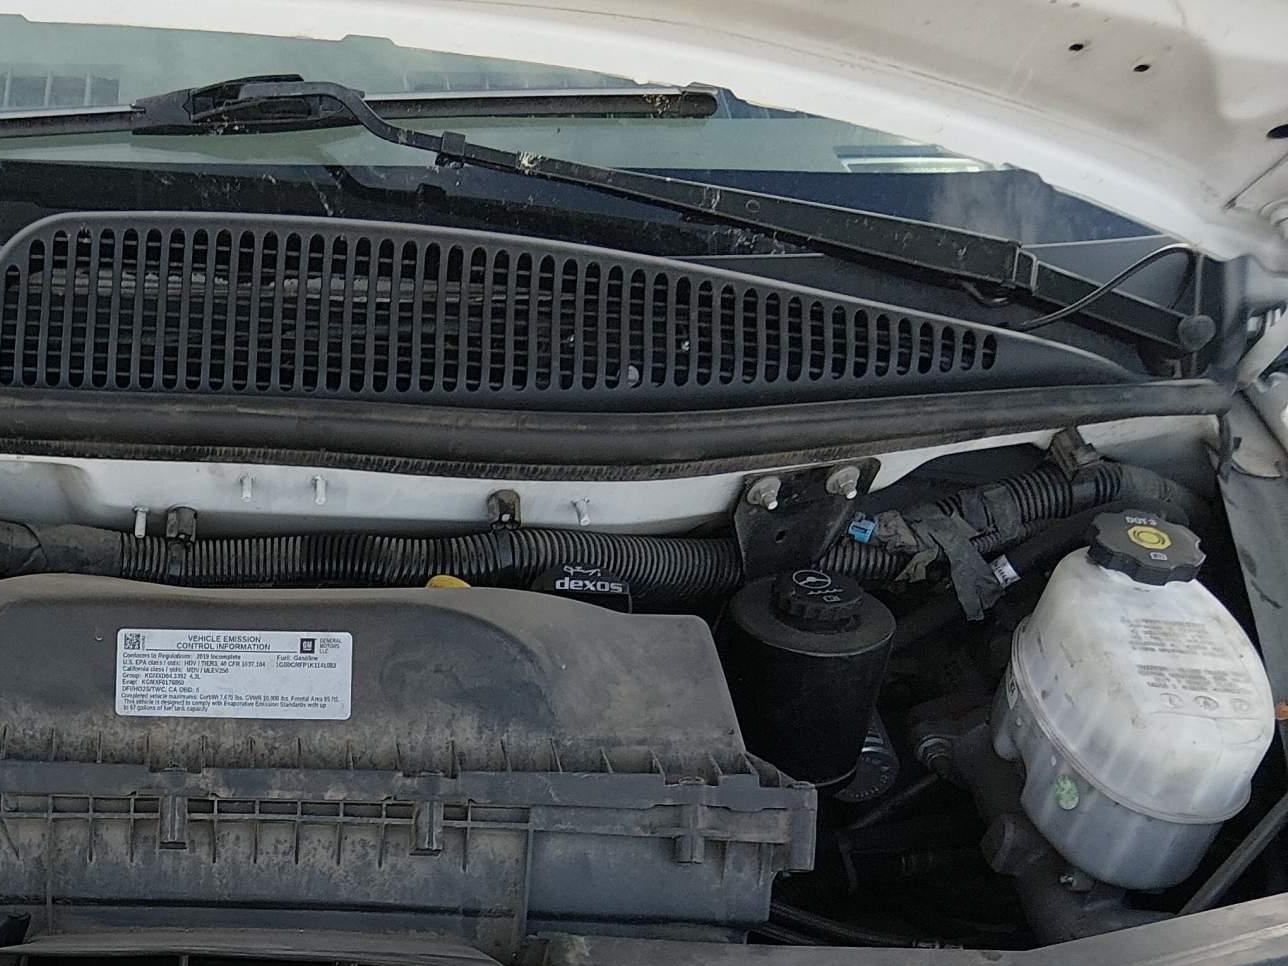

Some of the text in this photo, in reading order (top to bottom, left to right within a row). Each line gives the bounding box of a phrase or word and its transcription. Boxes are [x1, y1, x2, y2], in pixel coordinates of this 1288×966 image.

[555, 577, 623, 593] dexos
[223, 635, 261, 643] EMISSION
[176, 642, 271, 651] CONTROL INFORMATION
